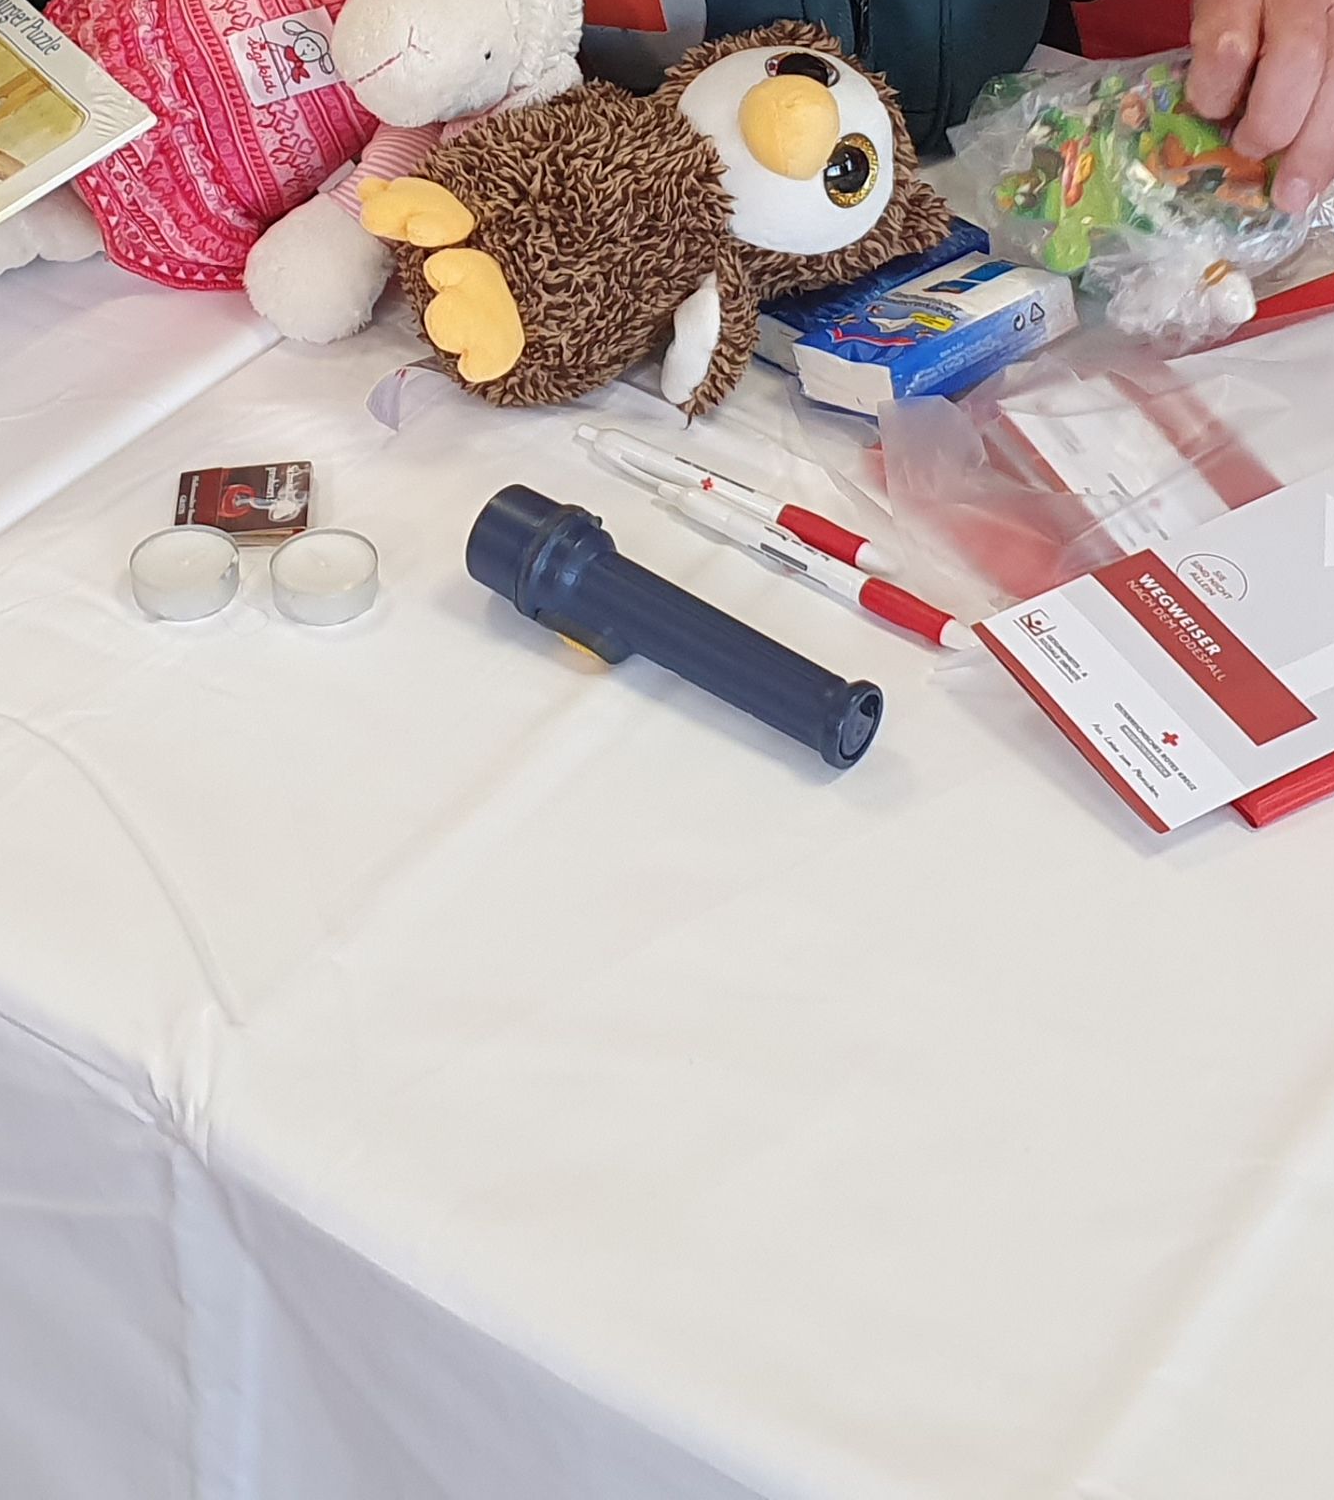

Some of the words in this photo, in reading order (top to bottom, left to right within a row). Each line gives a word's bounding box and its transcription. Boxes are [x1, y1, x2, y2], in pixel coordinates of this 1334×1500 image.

[26, 18, 64, 55] Puzzle
[1126, 580, 1155, 608] NACH
[1152, 605, 1178, 630] DEM
[1174, 628, 1227, 682] TODESFALL
[1138, 572, 1222, 656] WEGWEISER
